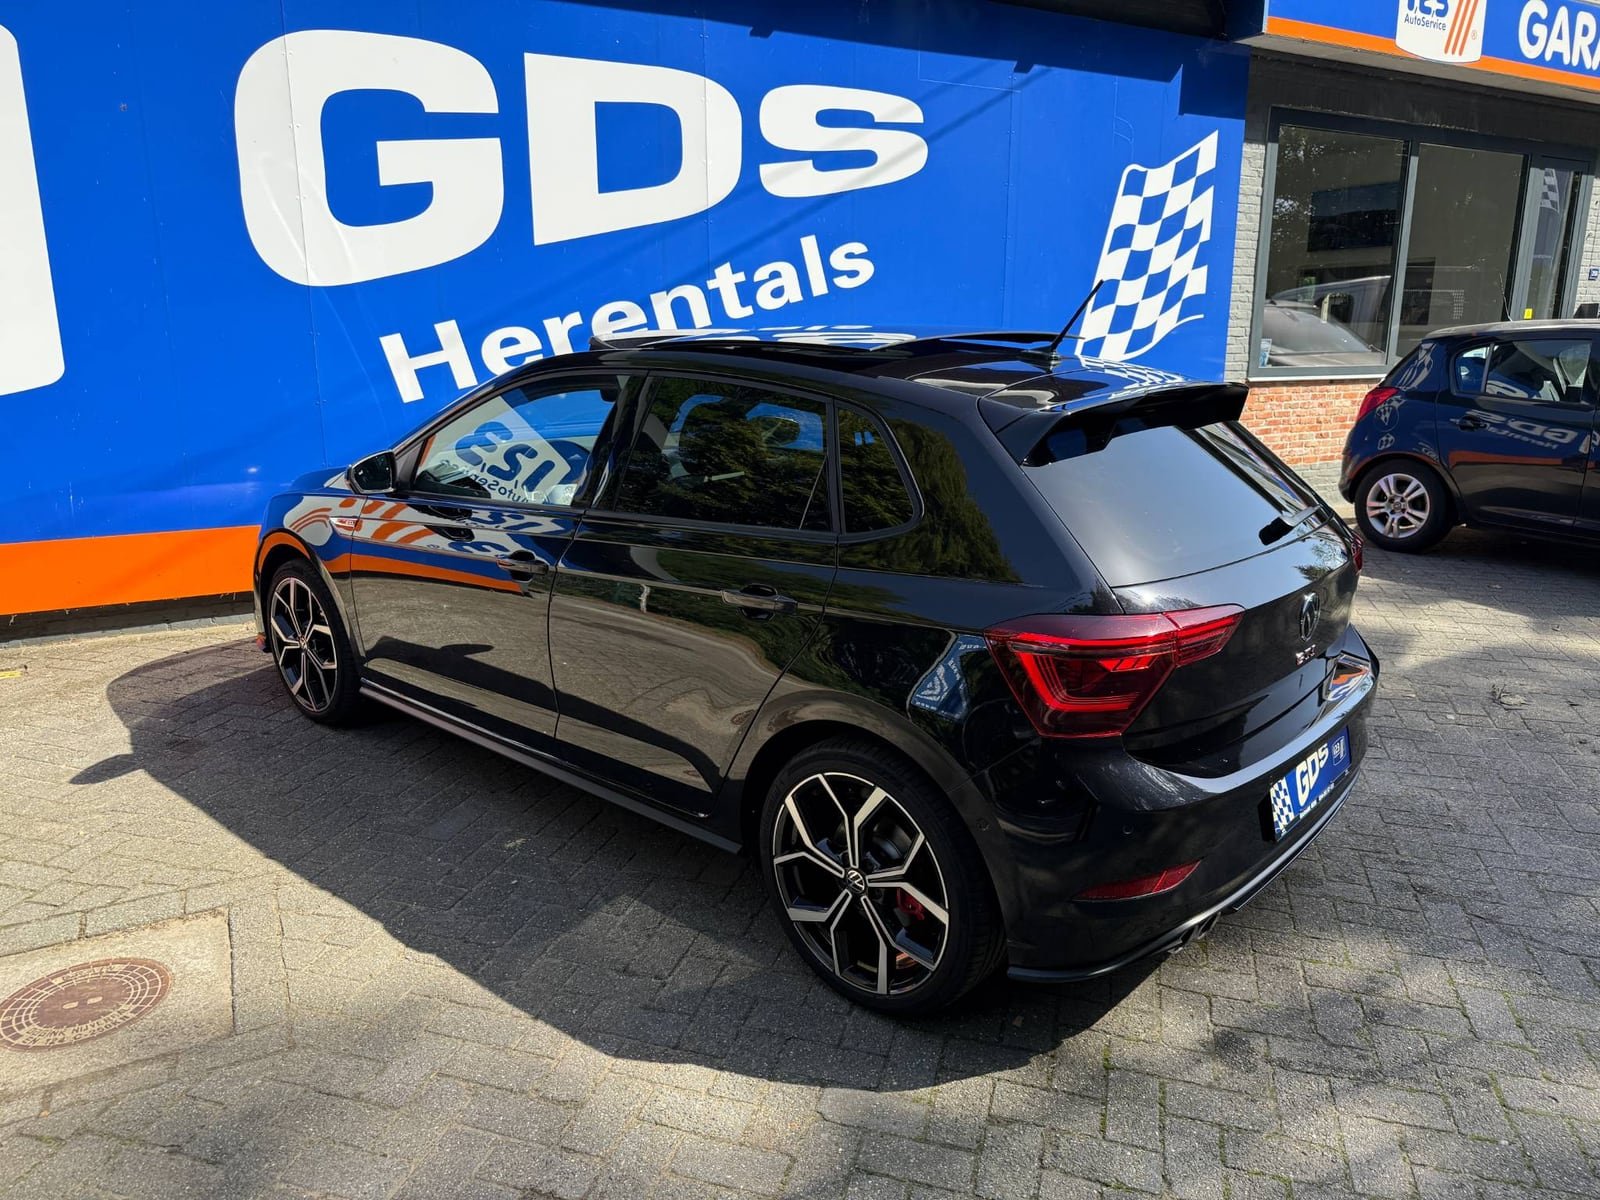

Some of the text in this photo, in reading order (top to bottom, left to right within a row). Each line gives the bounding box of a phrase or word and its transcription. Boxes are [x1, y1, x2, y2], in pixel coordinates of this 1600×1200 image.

[1404, 13, 1447, 31] AutoService
[1518, 0, 1600, 71] GAR
[234, 29, 928, 287] GDS
[379, 235, 875, 403] Herentals
[1296, 743, 1329, 807] GDS
